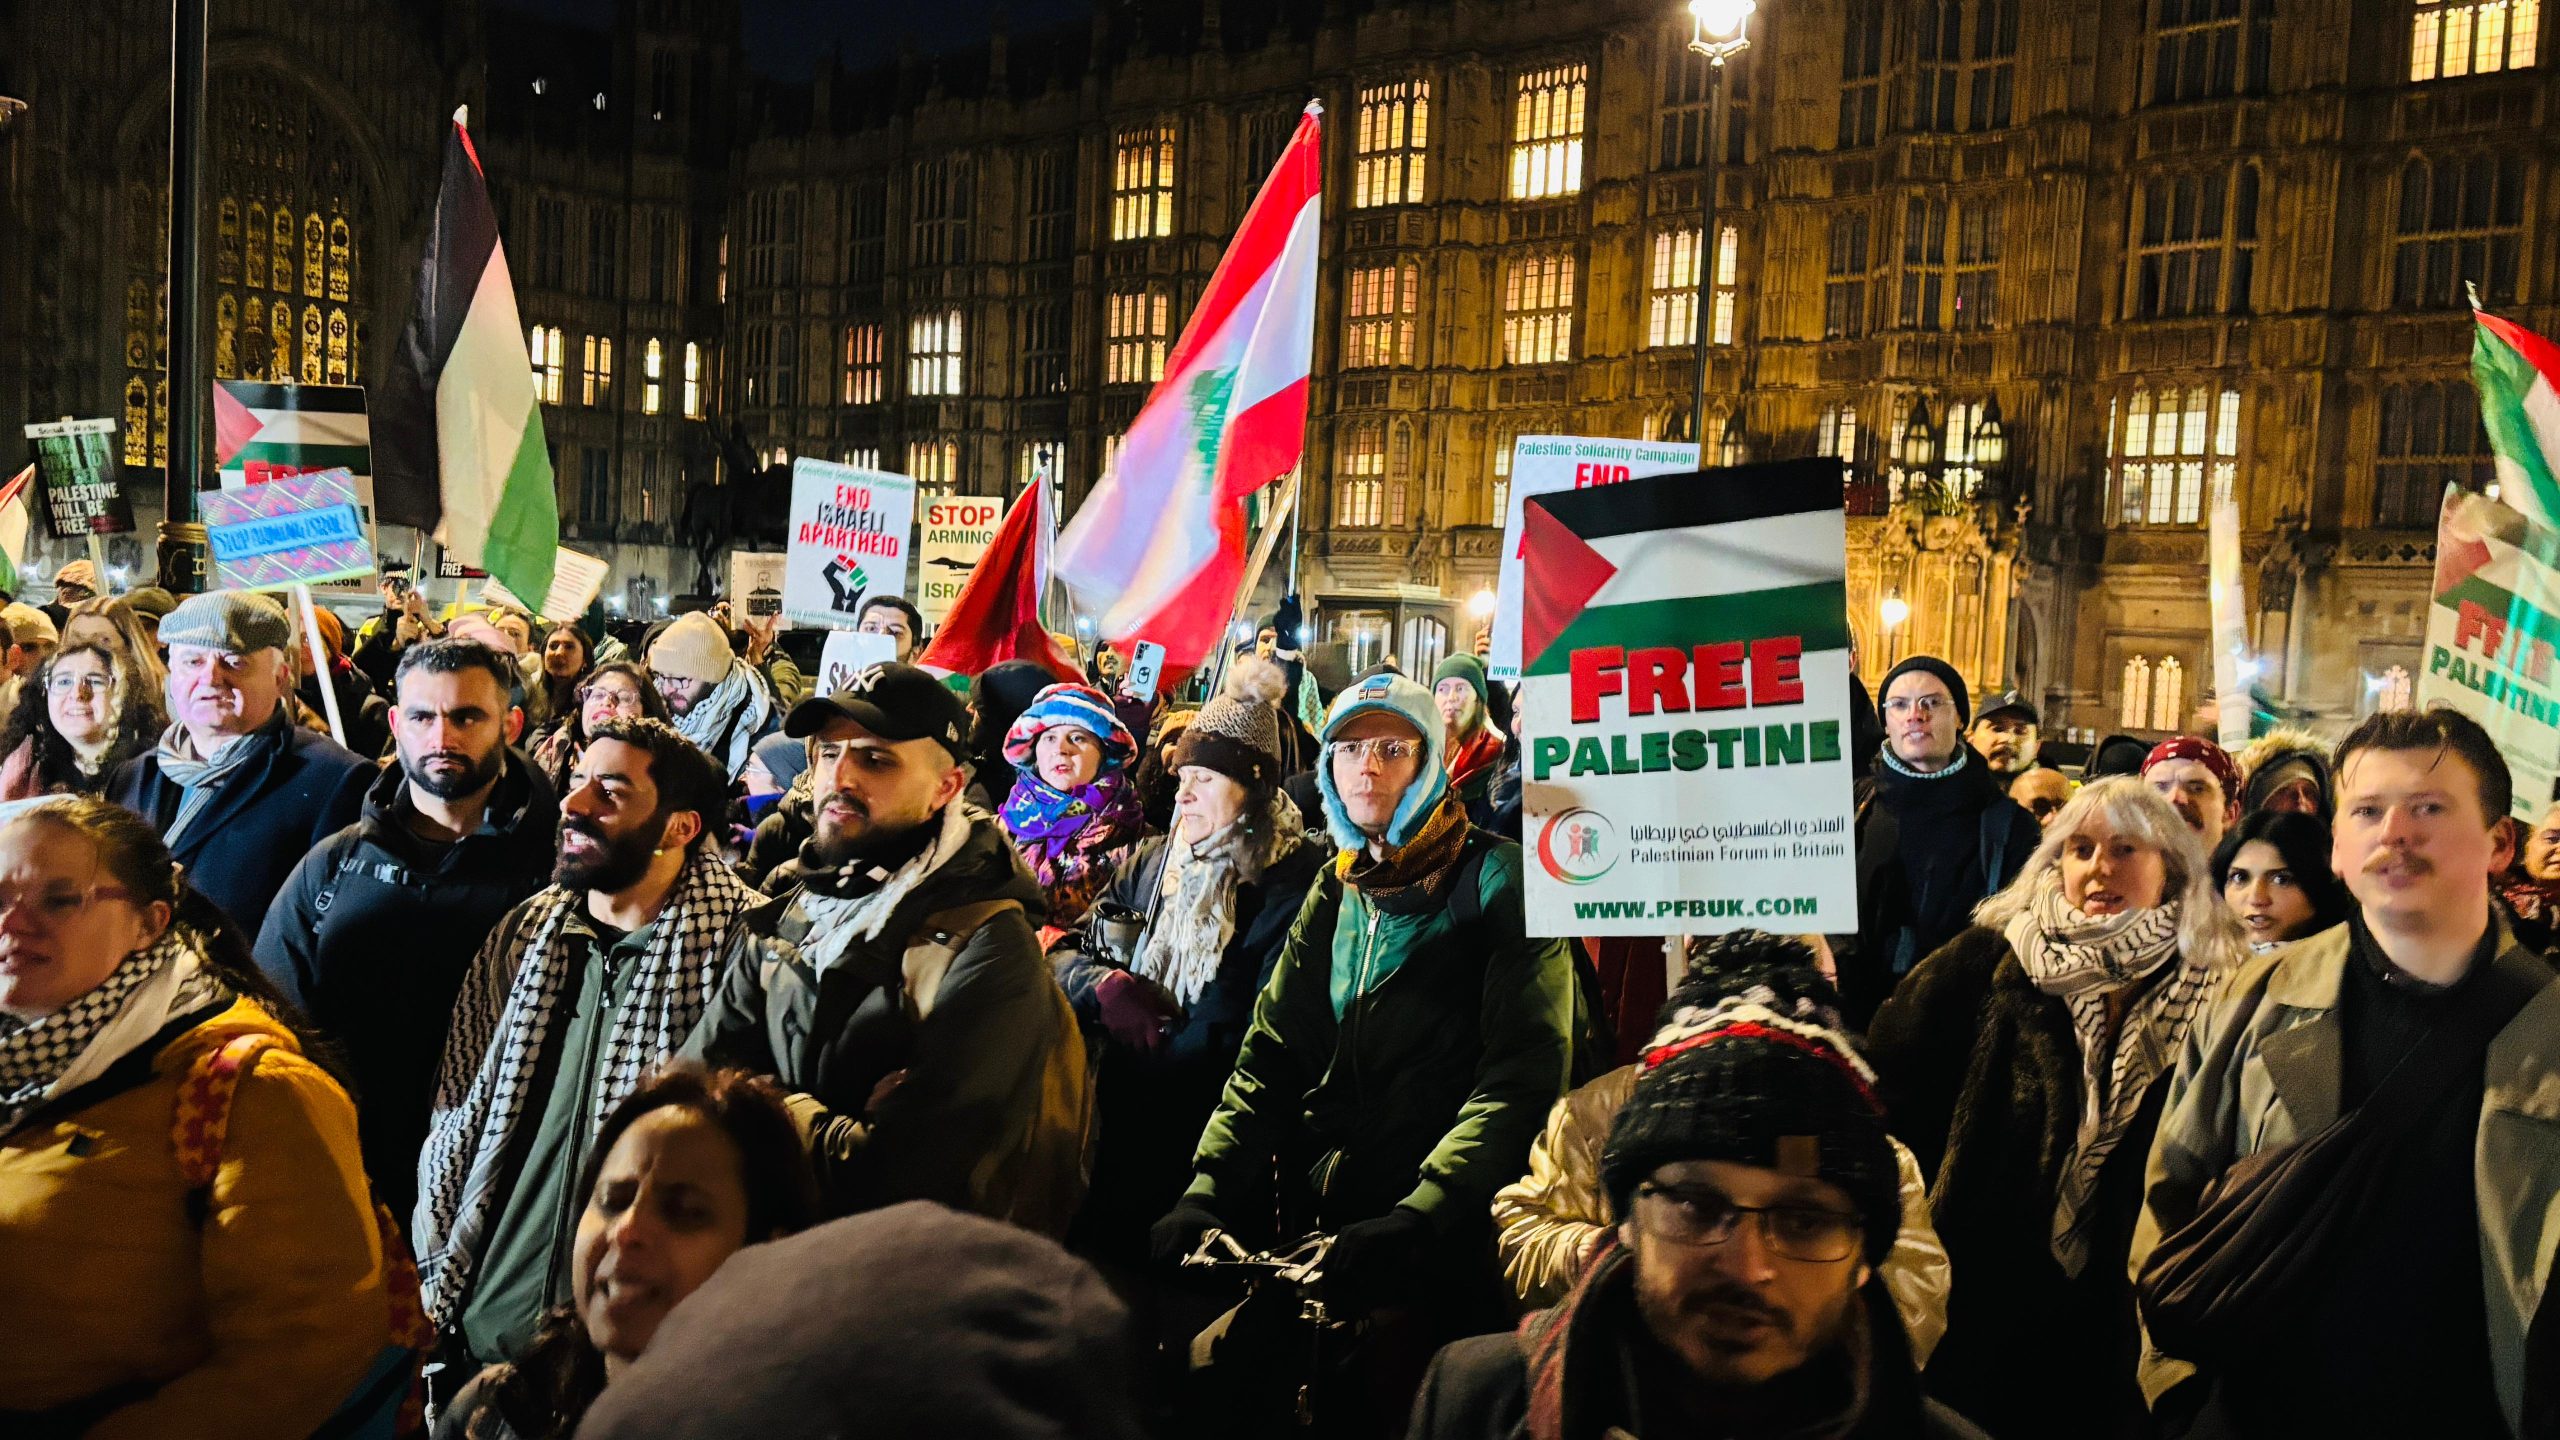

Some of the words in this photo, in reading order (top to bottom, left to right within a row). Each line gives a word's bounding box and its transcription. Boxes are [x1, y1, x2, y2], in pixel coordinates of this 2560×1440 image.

[1517, 442, 1572, 456] Palestine
[1575, 443, 1632, 461] Solidarity
[1635, 448, 1695, 465] Campaign
[48, 482, 119, 502] PALESTINE
[836, 484, 872, 511] END
[51, 501, 84, 519] WILL
[86, 499, 106, 517] BE
[818, 501, 885, 533] ISRAELI
[929, 505, 995, 526] STOP
[798, 522, 899, 558] APARTHEID
[927, 530, 994, 544] ARMING
[441, 562, 463, 577] FREE
[1569, 635, 1804, 724] FREE
[1533, 720, 1841, 780] PALESTINE
[1631, 846, 1714, 863] Palestinian
[1720, 844, 1768, 861] Forum
[1773, 842, 1786, 859] in
[1793, 839, 1844, 858] Britain
[1574, 896, 1818, 919] WWW.PFBUK.COM
